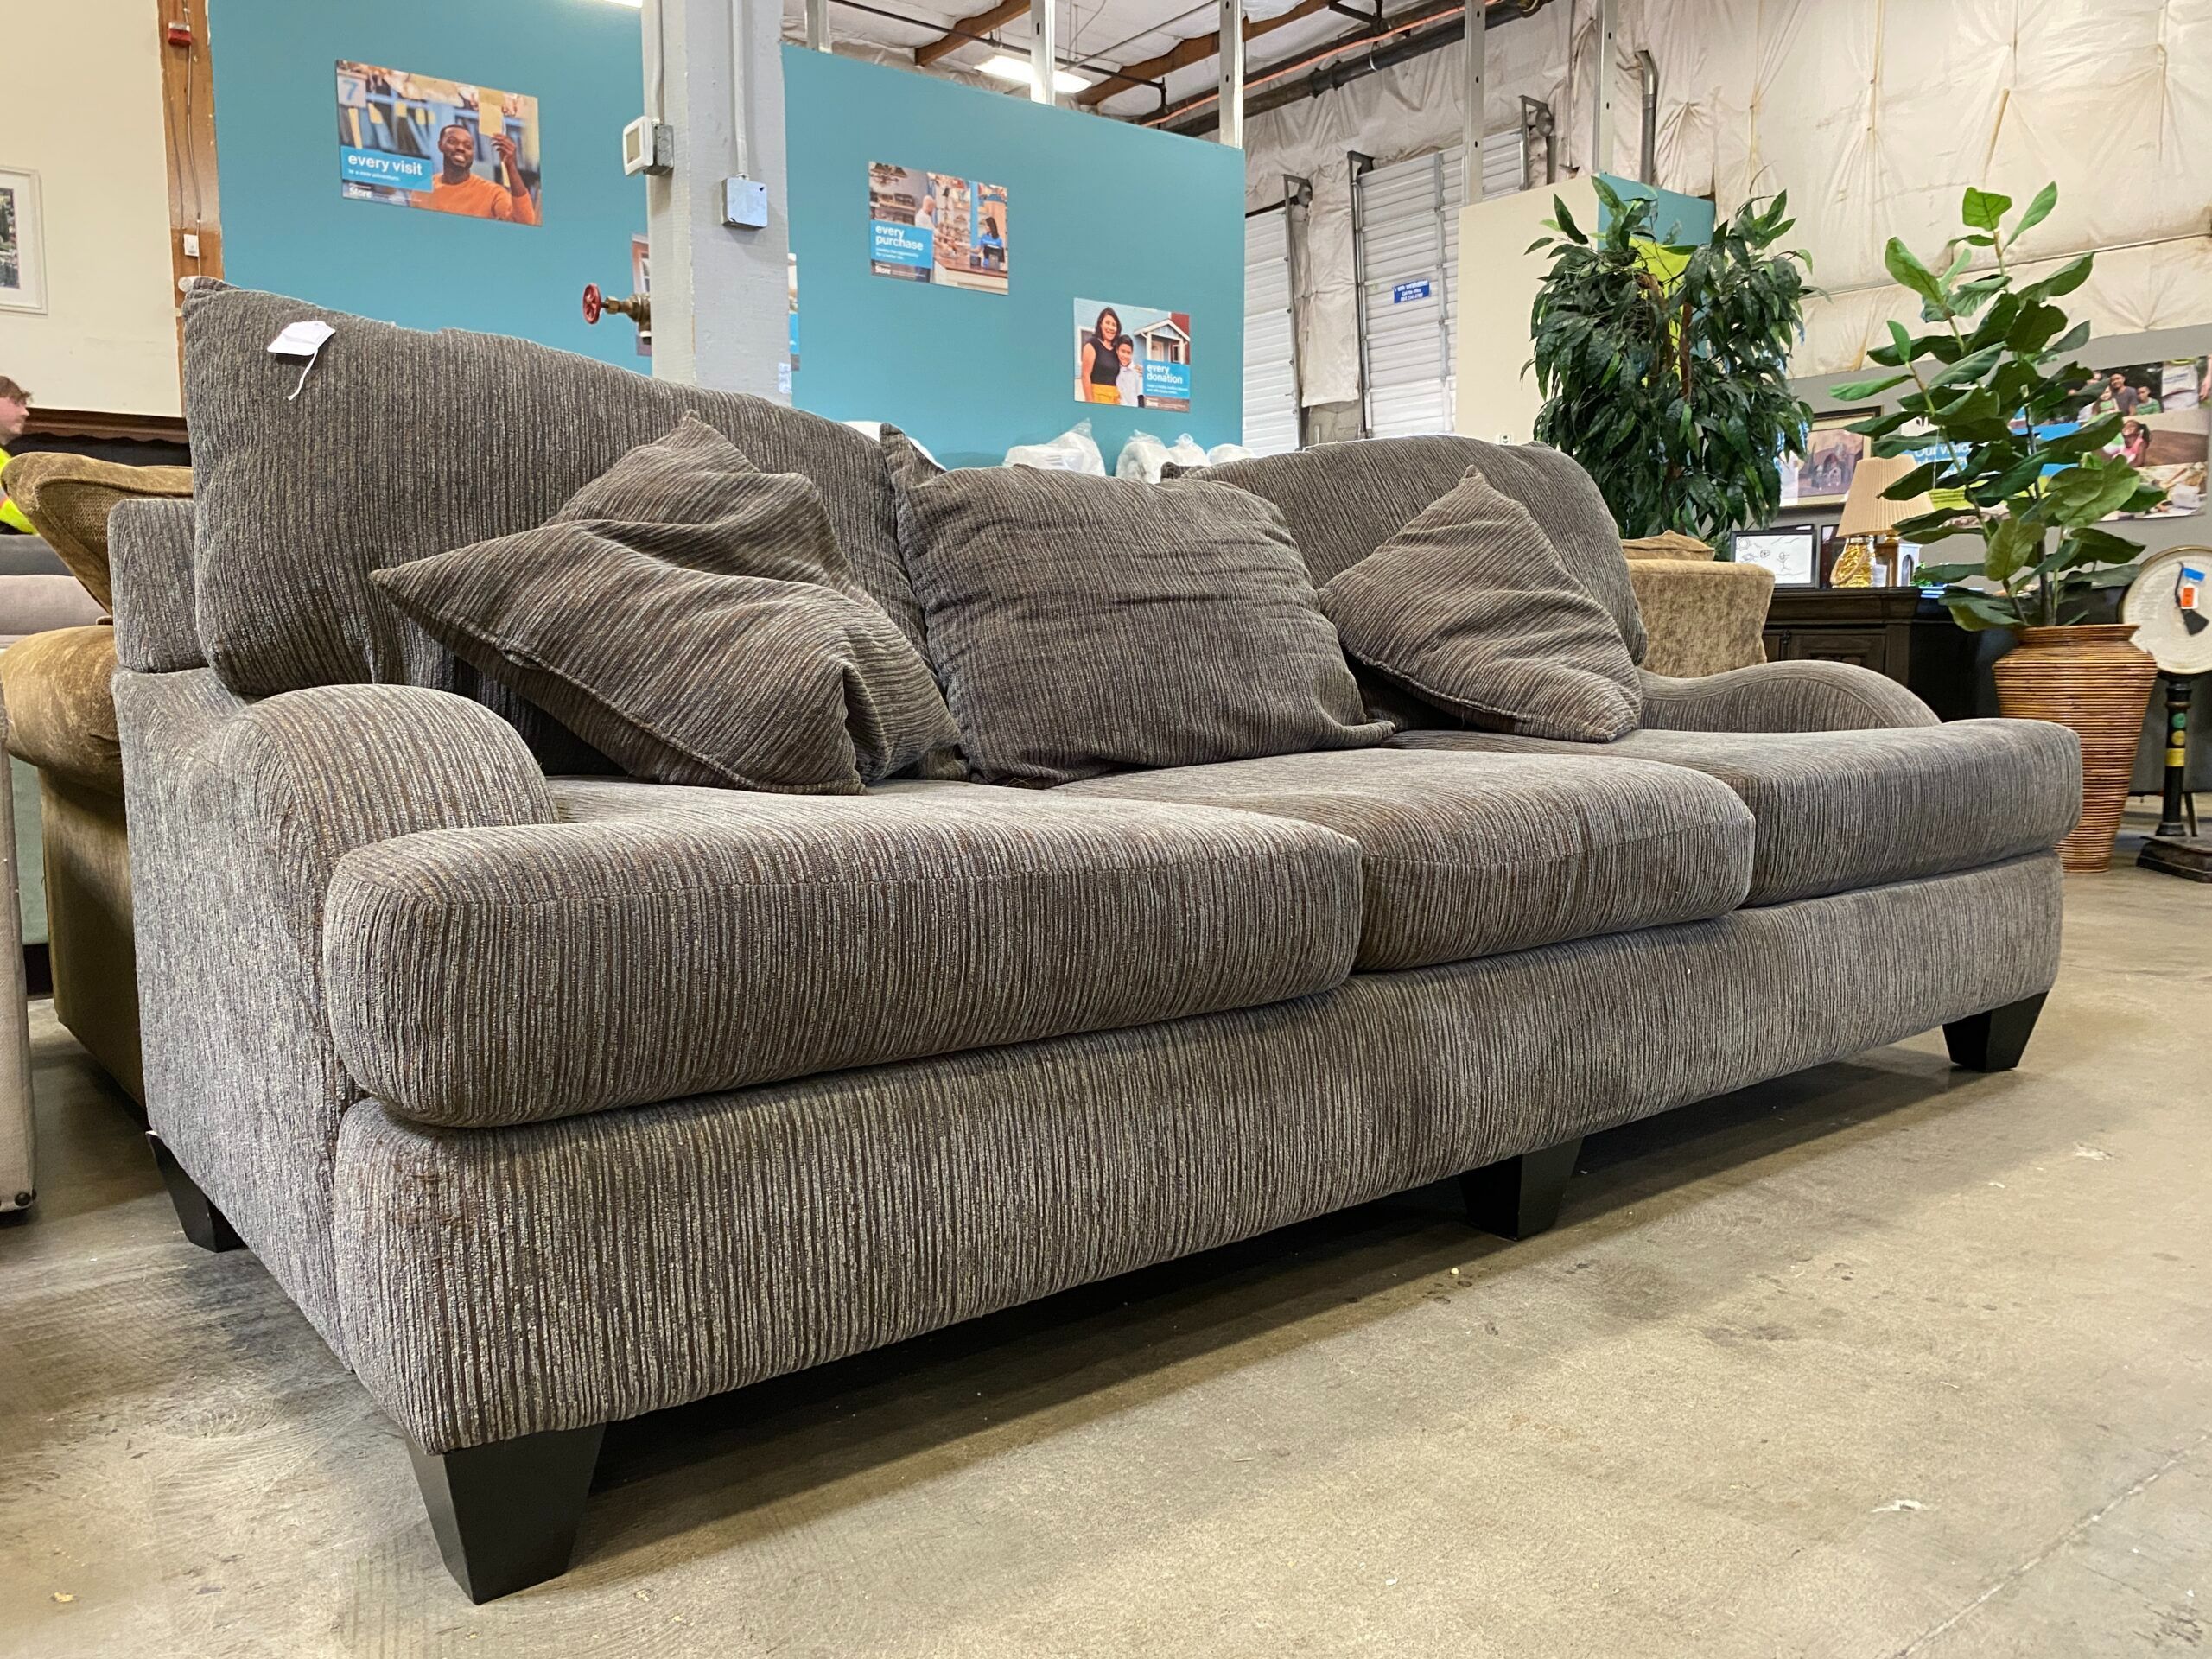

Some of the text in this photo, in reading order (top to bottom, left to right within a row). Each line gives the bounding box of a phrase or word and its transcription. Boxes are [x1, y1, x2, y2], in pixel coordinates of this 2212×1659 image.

[348, 155, 390, 173] every
[392, 160, 423, 176] visit
[875, 226, 905, 239] every
[875, 236, 924, 251] purchase
[1147, 364, 1170, 375] every
[1147, 372, 1183, 384] donation
